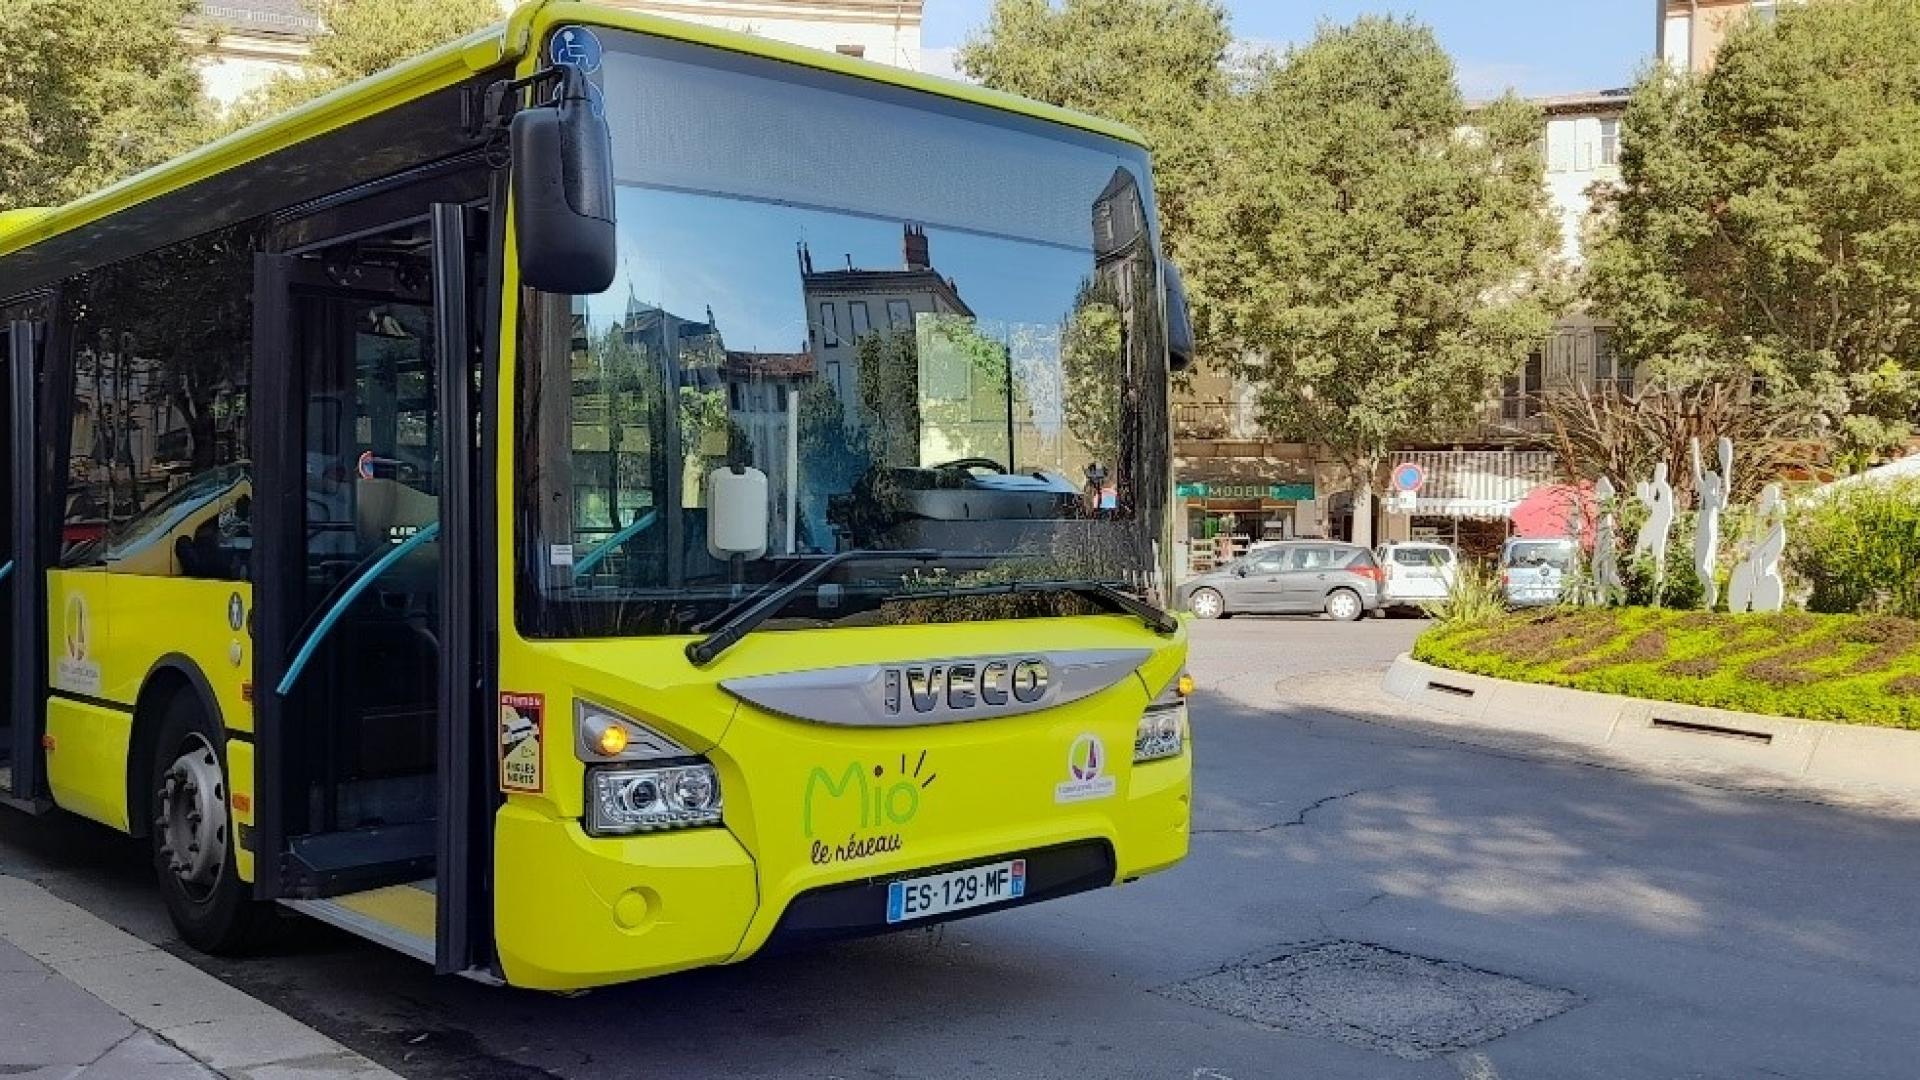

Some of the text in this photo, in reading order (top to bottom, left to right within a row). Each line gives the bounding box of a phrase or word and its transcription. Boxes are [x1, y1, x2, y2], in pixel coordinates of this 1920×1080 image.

[884, 658, 1049, 717] IVECO
[803, 761, 919, 839] Mio
[810, 832, 903, 865] le réseau
